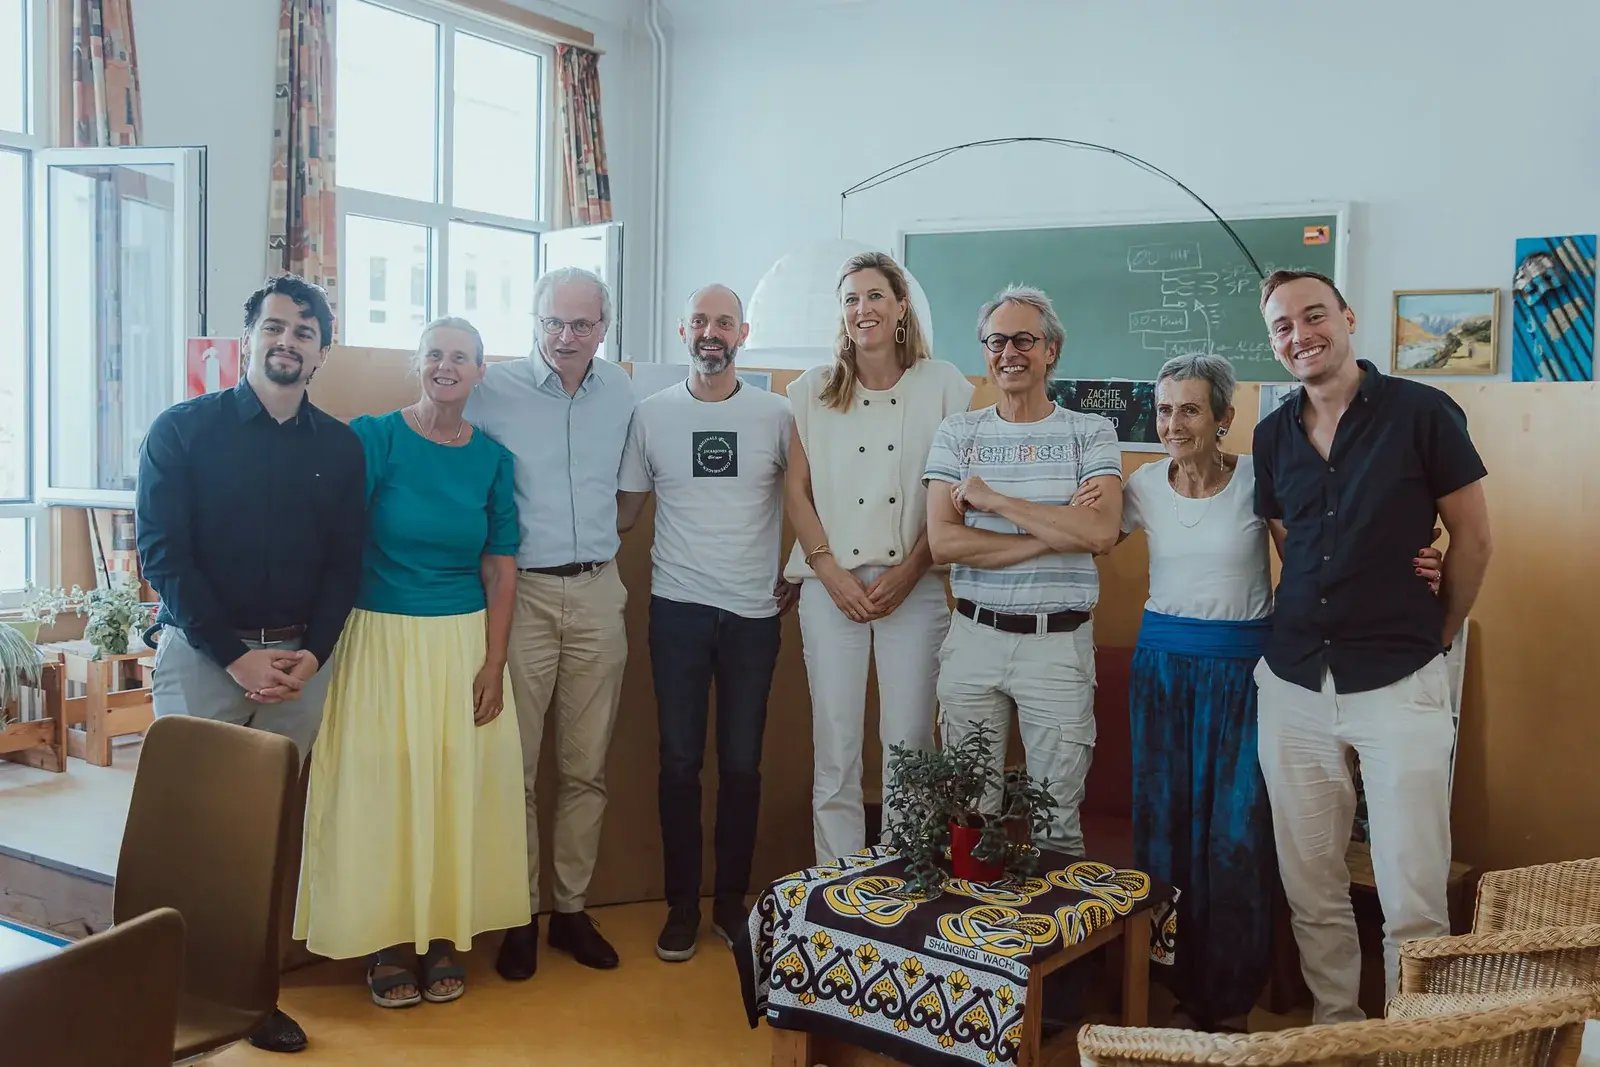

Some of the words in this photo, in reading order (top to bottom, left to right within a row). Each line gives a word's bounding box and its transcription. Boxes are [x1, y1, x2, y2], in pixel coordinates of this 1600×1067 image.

[1087, 388, 1120, 399] ZACHTE
[1080, 398, 1127, 408] KRACHTEN
[929, 938, 978, 960] SHANGINGI
